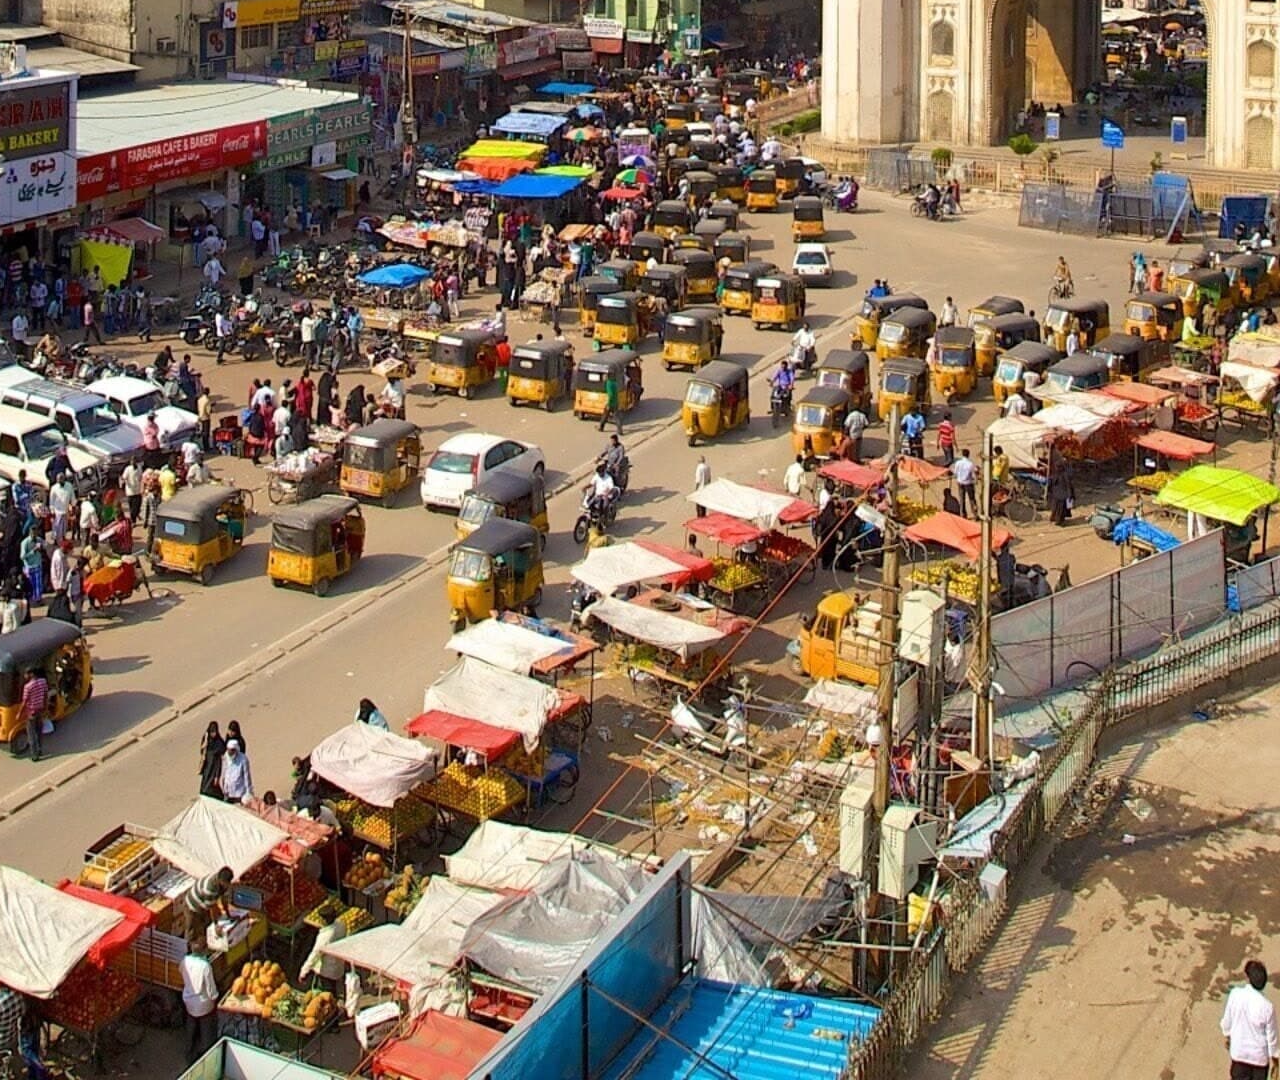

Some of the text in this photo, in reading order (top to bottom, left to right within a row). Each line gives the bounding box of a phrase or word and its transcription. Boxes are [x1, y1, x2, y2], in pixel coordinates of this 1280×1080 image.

[315, 111, 370, 134] PEARLS
[8, 127, 60, 150] BAKERY
[222, 135, 249, 153] Coca-Cola
[268, 125, 314, 146] PEARLS
[127, 133, 218, 163] FARASHA CAFE & BAKERY
[259, 151, 307, 168] PEARLS
